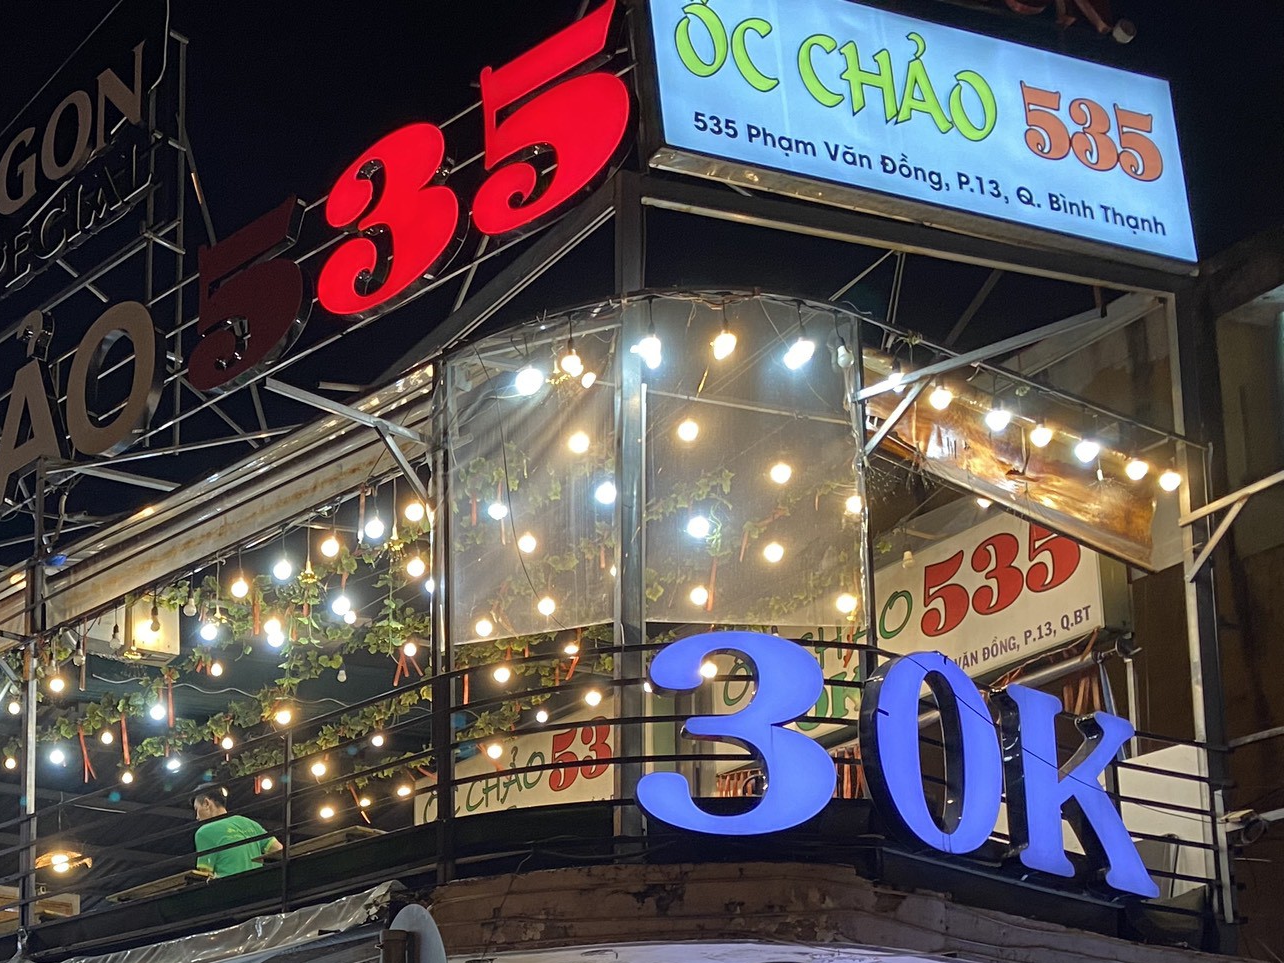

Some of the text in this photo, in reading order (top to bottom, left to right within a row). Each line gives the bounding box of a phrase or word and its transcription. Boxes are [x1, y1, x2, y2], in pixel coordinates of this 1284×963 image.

[693, 111, 739, 139] 535
[747, 123, 817, 157] Phạm
[825, 140, 873, 172] Văn
[880, 151, 951, 193] Đồng,
[957, 172, 1010, 204] P.13,
[1048, 189, 1096, 220] Bình
[1100, 204, 1167, 238] Thạnh
[797, 32, 998, 142] CHẢO
[1019, 80, 1164, 183] 535
[187, 0, 632, 394] 535
[920, 521, 1081, 638] 535
[982, 636, 1020, 661] ĐỒNG,
[1023, 621, 1057, 645] P.13,
[1060, 605, 1092, 630] Q.BT
[634, 630, 1161, 899] 30K
